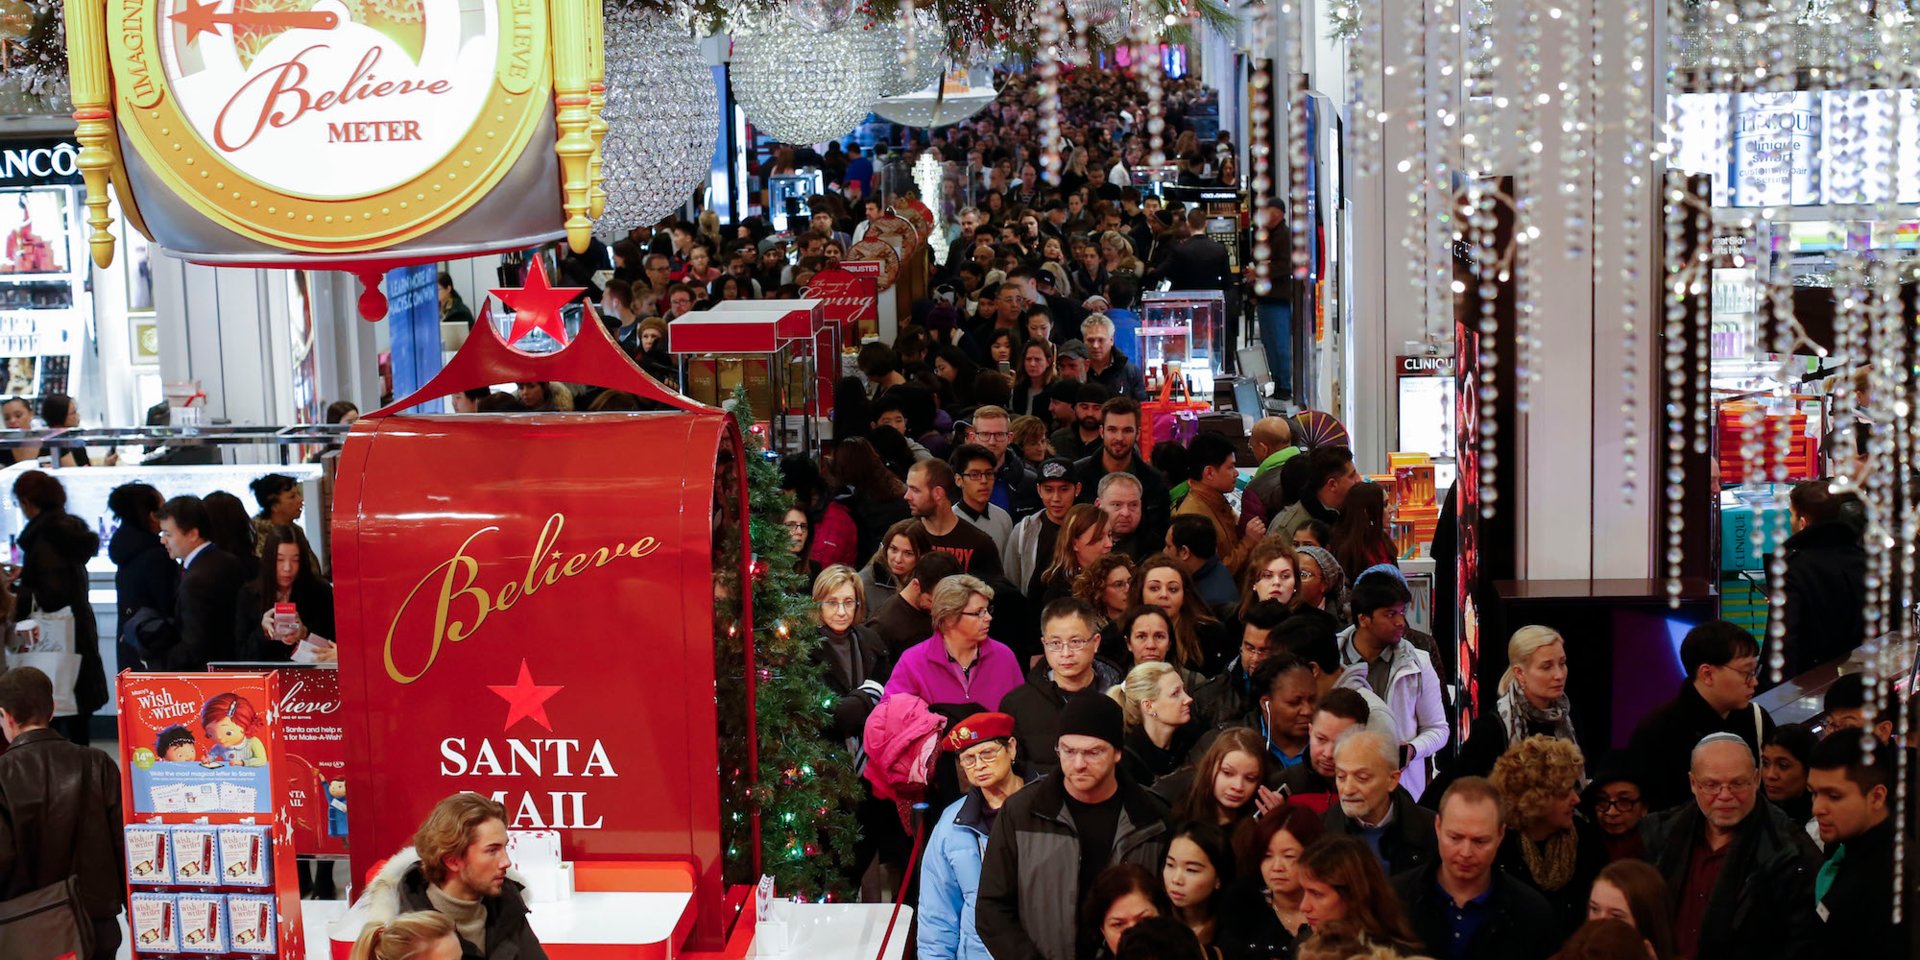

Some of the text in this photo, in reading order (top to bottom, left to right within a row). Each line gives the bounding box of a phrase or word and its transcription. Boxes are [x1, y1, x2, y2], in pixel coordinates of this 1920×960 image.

[213, 44, 453, 152] Believe
[327, 120, 422, 143] METER
[0, 142, 84, 178] NCÔ
[1404, 358, 1455, 370] CLINIQU
[1735, 513, 1746, 567] CLINIQUE
[383, 512, 662, 684] Believe
[137, 687, 174, 709] wish
[152, 700, 197, 720] writer
[440, 737, 618, 777] SANTA
[459, 791, 604, 829] AIL
